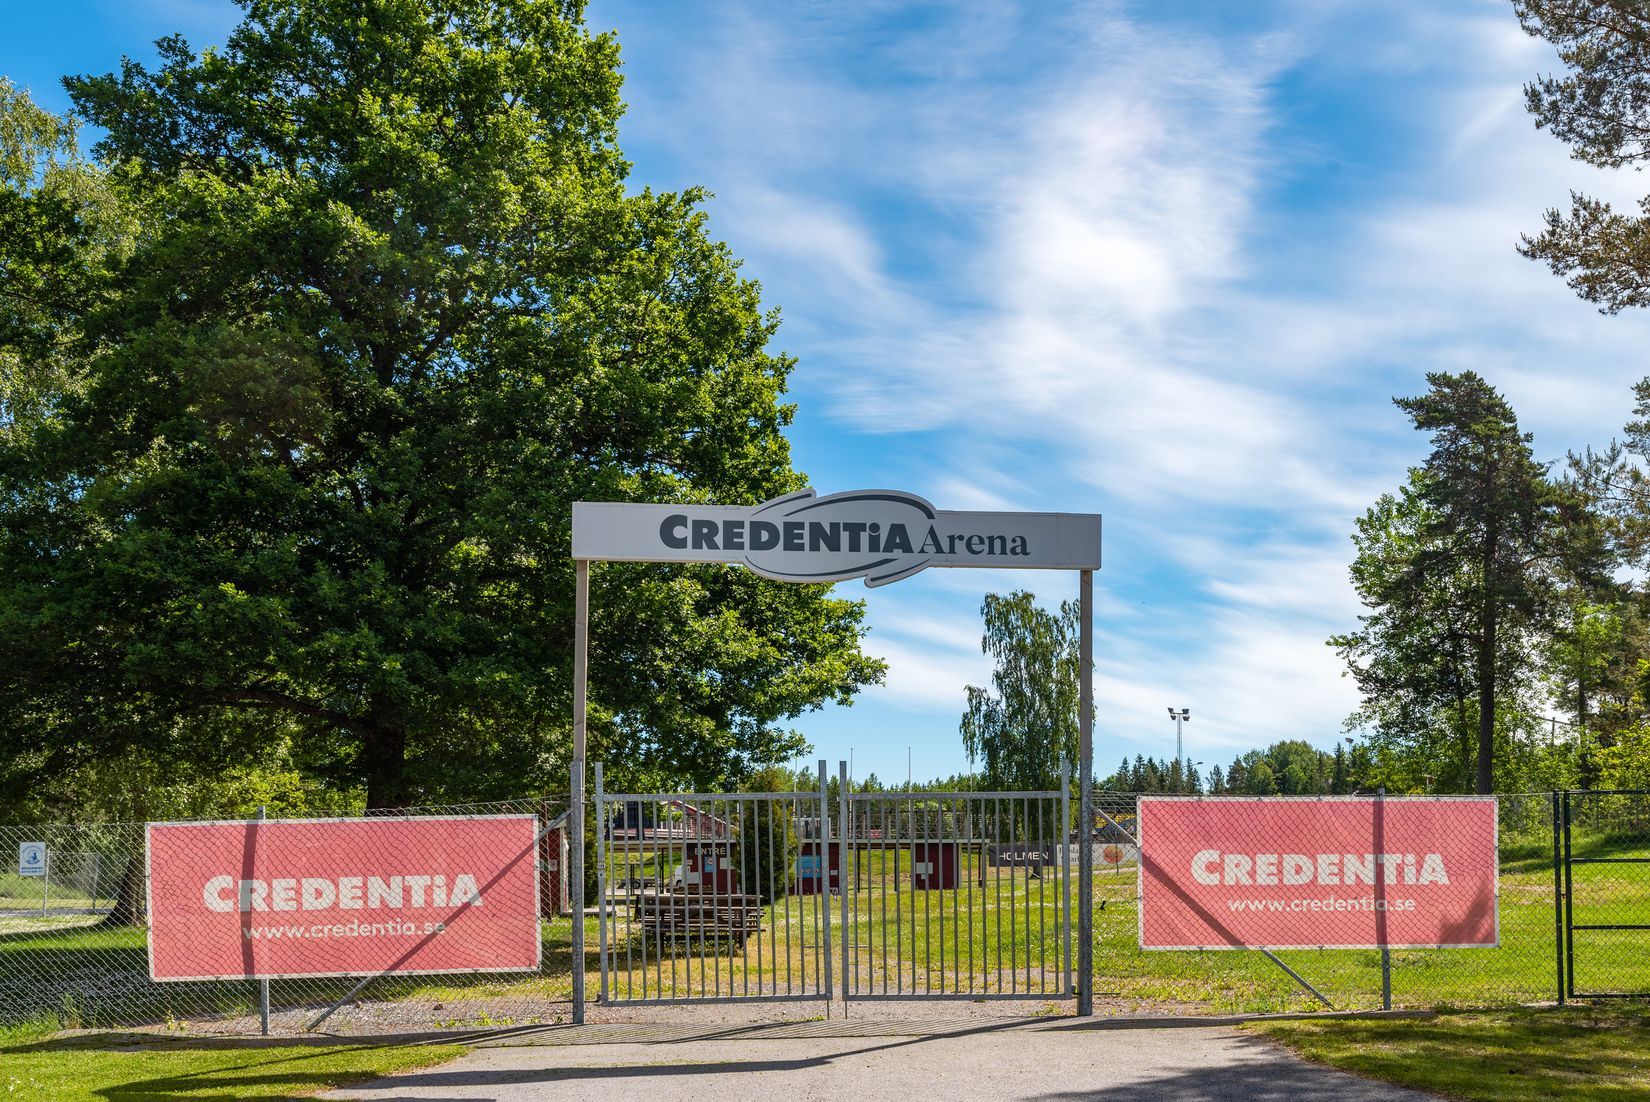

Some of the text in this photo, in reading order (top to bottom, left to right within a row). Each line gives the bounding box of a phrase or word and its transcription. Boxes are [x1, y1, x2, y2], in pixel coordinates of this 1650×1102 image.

[917, 520, 1031, 557] Arena
[997, 851, 1049, 861] HOLMEN
[1227, 895, 1416, 912] www.credentia.se
[242, 918, 446, 940] www.credentia.se
